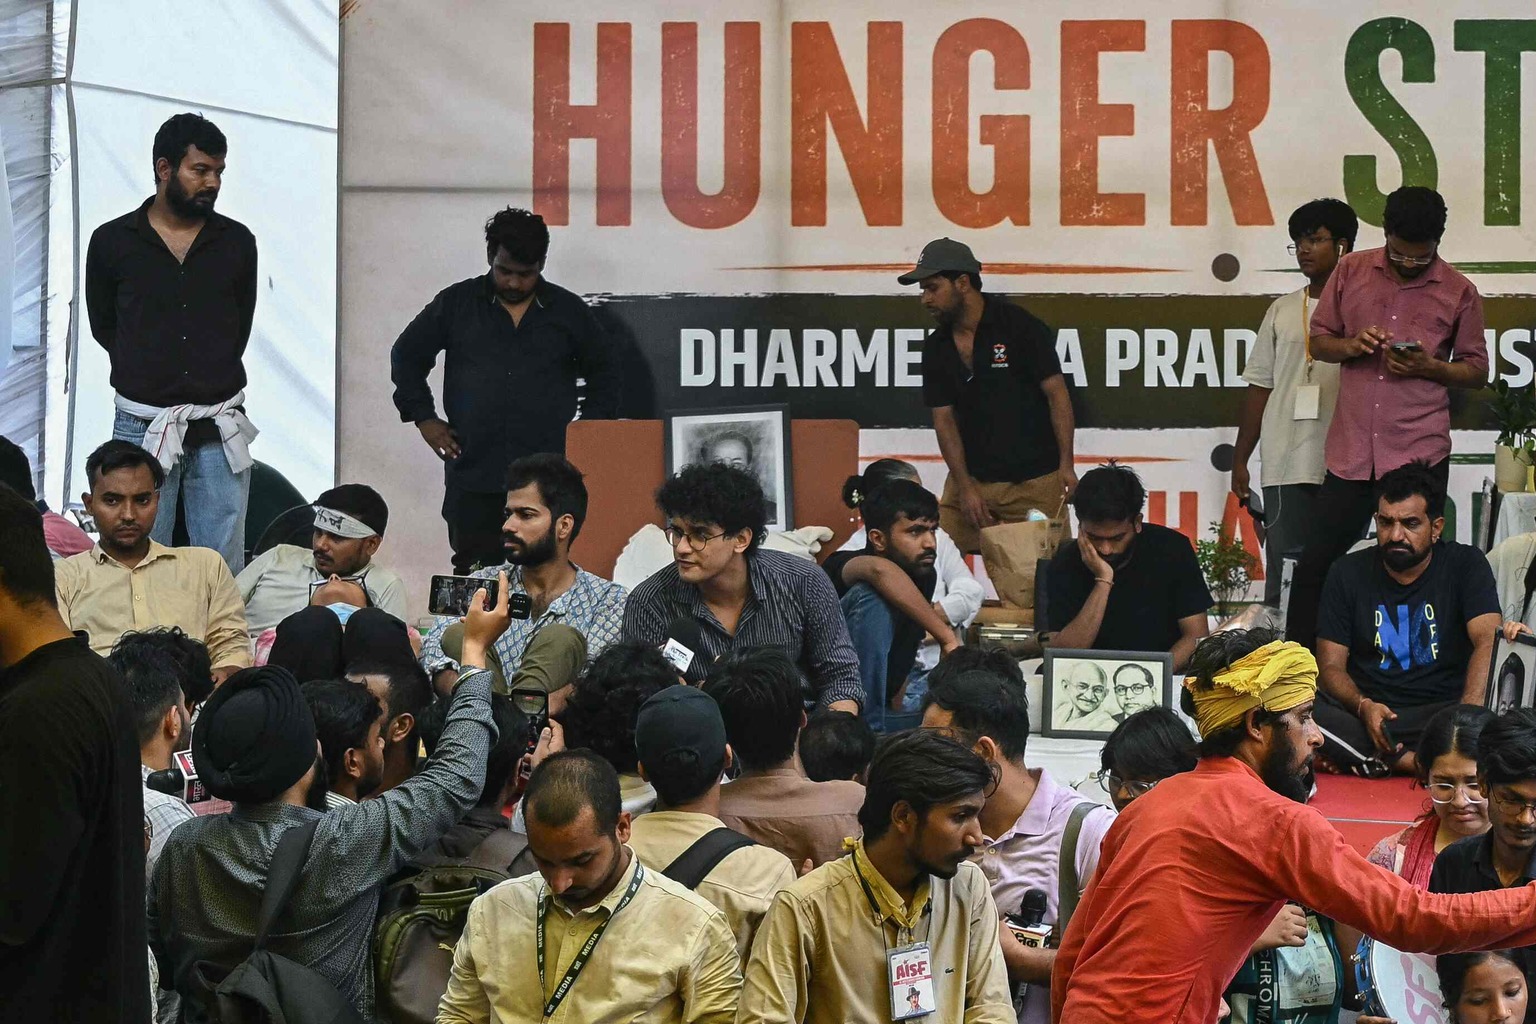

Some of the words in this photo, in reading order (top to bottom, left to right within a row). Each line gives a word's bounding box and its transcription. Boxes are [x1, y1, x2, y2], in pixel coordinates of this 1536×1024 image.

[532, 17, 1275, 229] HUNGER
[679, 328, 1088, 387] DHARMEA
[1424, 603, 1439, 660] OFF
[581, 932, 599, 956] MEDIA
[555, 976, 573, 1000] MEDIA
